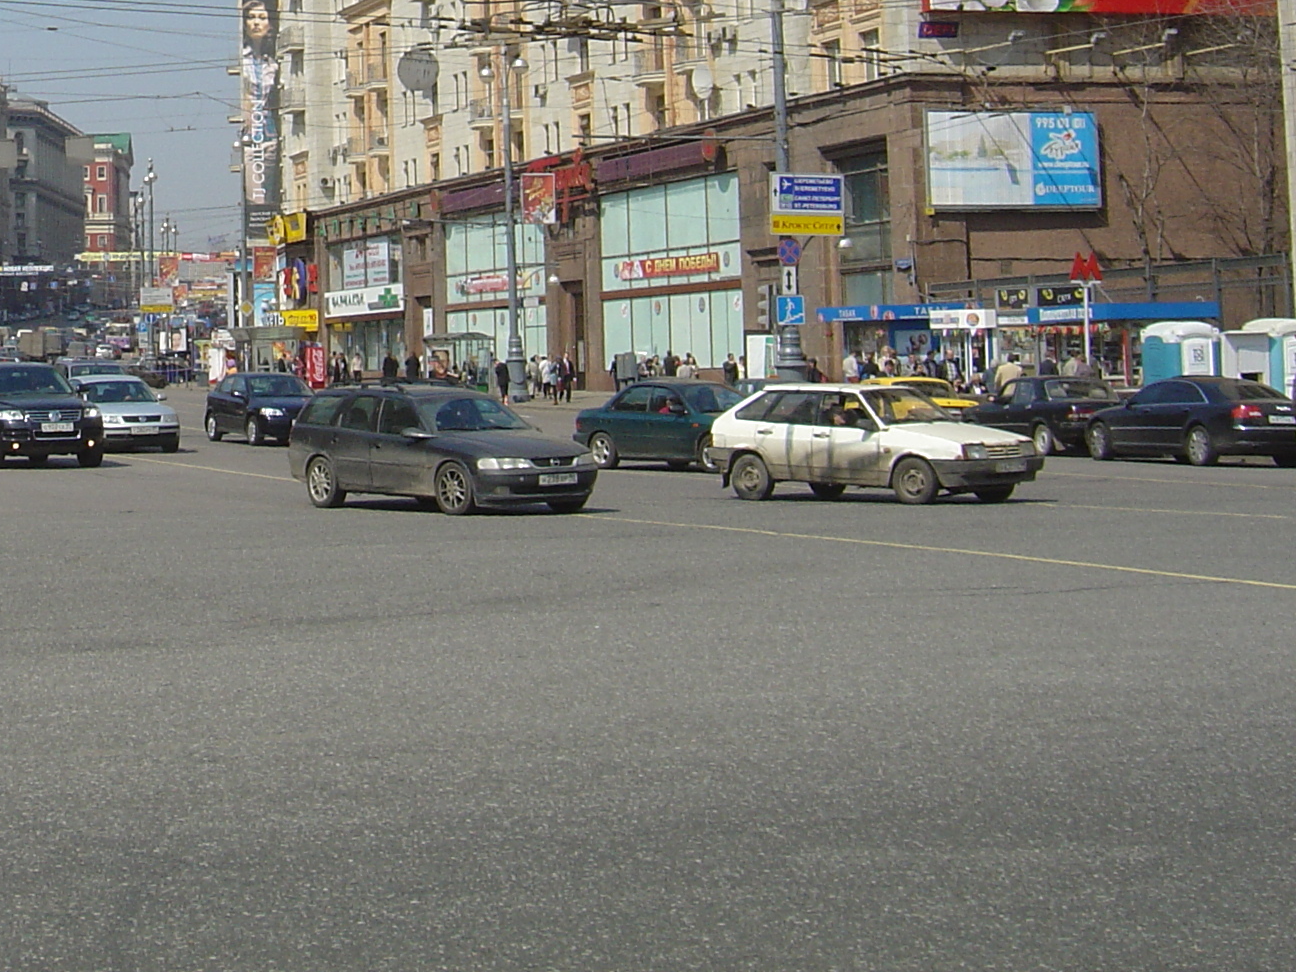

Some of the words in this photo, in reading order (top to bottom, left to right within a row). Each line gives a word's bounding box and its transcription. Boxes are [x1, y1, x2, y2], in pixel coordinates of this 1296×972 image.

[251, 99, 265, 184] COLLECTION
[654, 257, 677, 272] ДНЕМ
[678, 253, 718, 271] ПОБЕДЫ!
